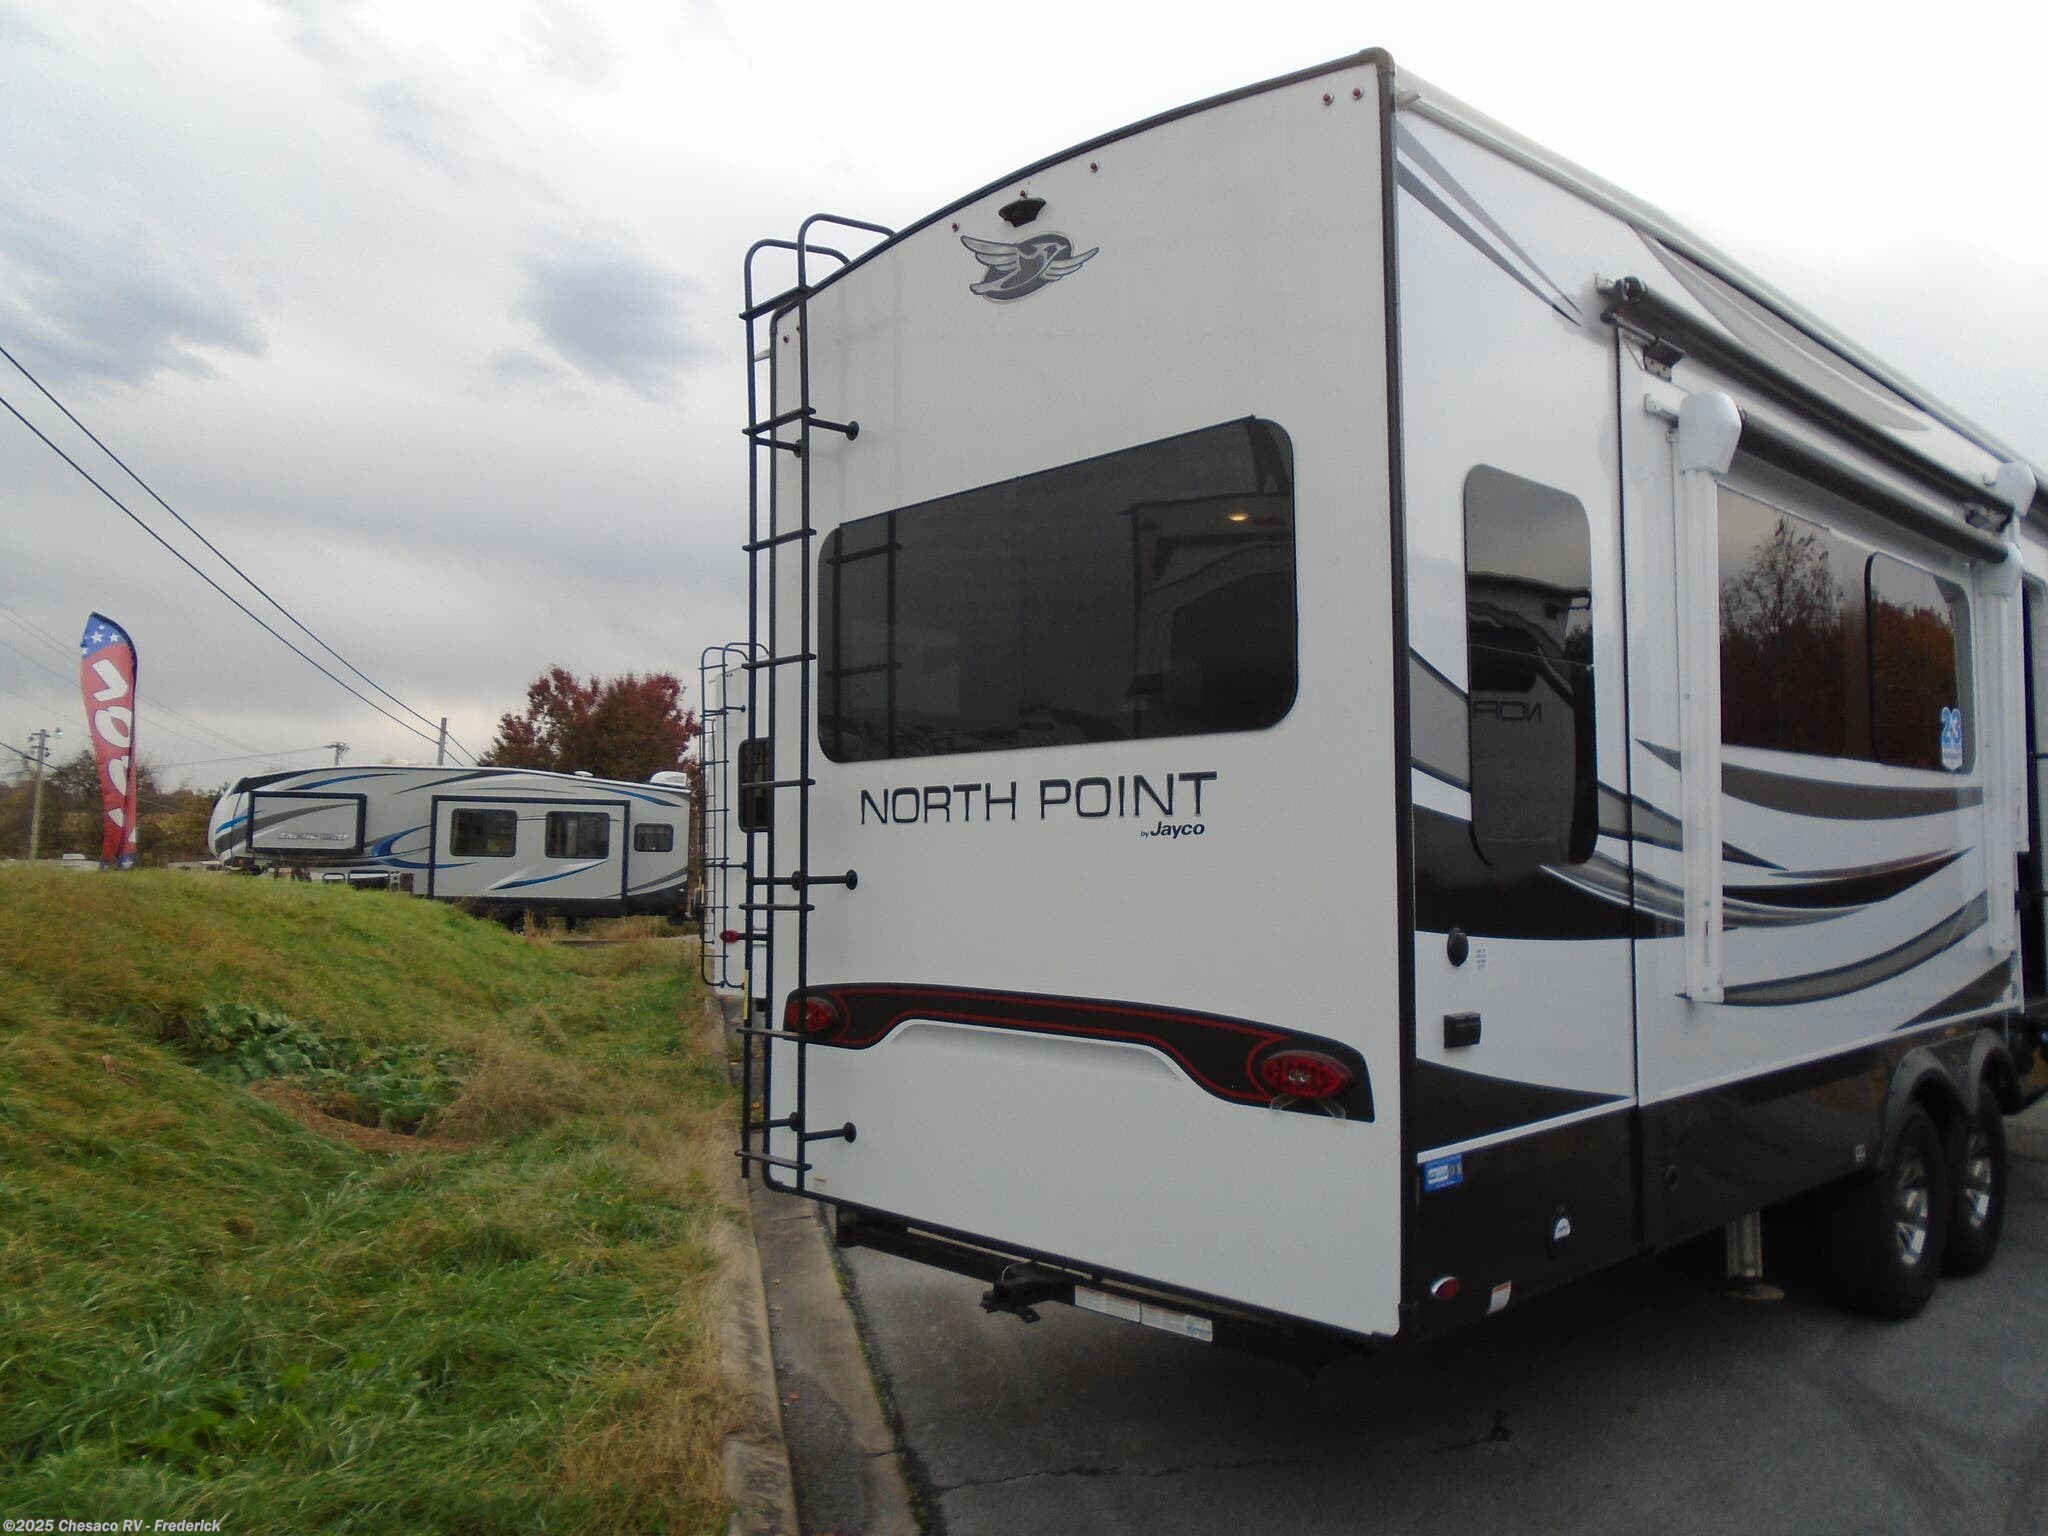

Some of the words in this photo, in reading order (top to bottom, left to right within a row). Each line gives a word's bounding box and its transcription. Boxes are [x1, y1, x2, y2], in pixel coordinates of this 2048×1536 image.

[860, 780, 1017, 825] NORTH
[1039, 770, 1218, 821] POINT
[1140, 829, 1150, 839] by
[1150, 821, 1205, 839] Jayco
